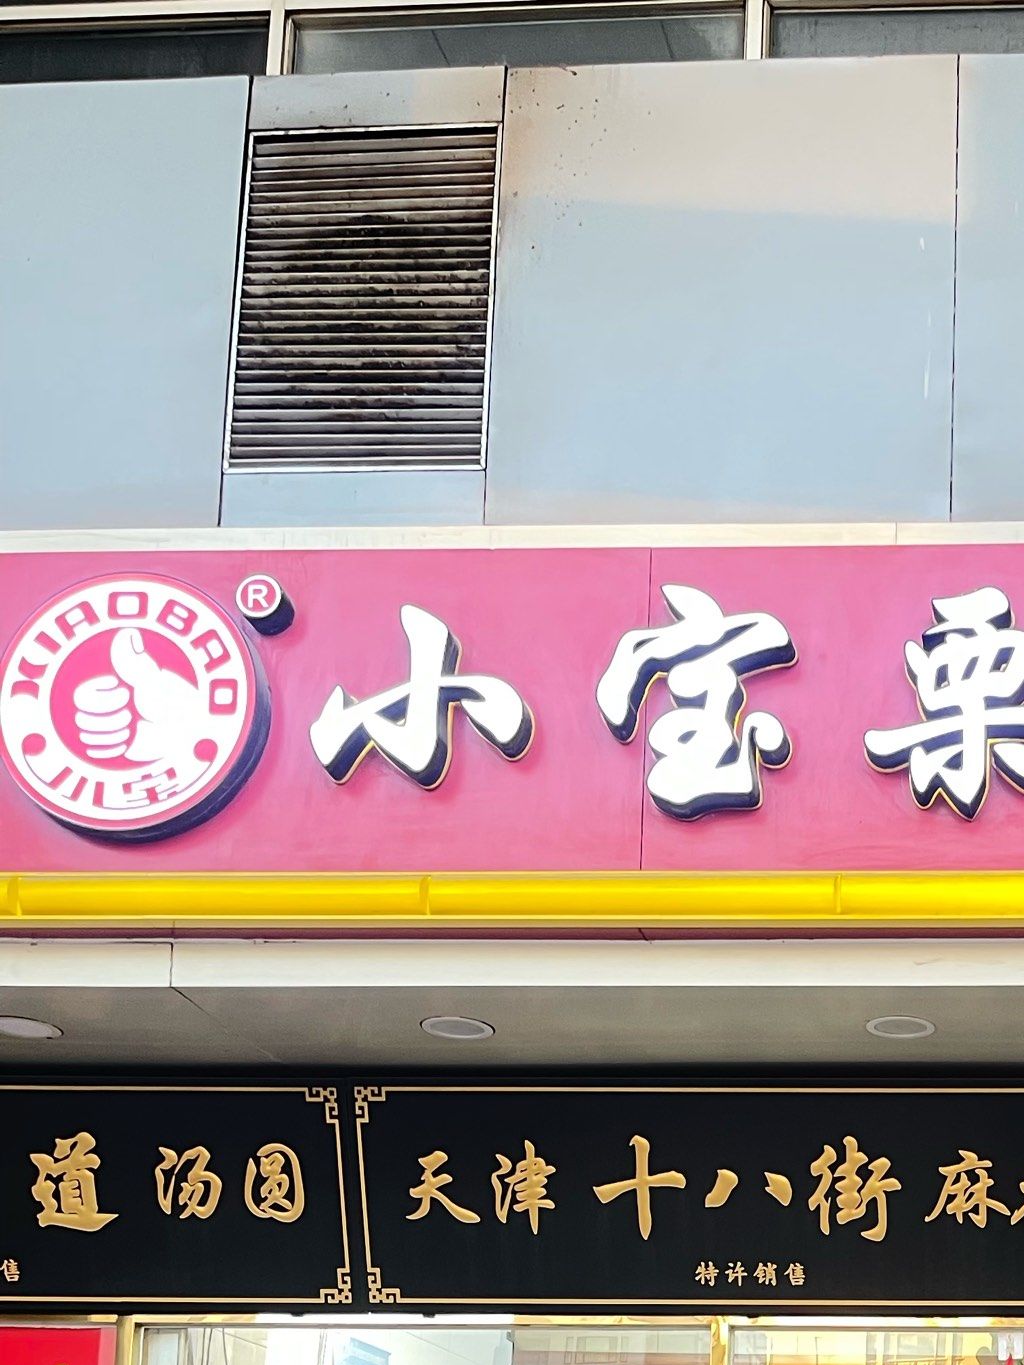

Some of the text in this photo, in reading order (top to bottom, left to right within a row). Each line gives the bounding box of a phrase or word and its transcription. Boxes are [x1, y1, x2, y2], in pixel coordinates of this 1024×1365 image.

[11, 591, 239, 716] XIAOBAO
[29, 1132, 304, 1231] 道汤圆
[694, 1261, 807, 1288] 特许销售
